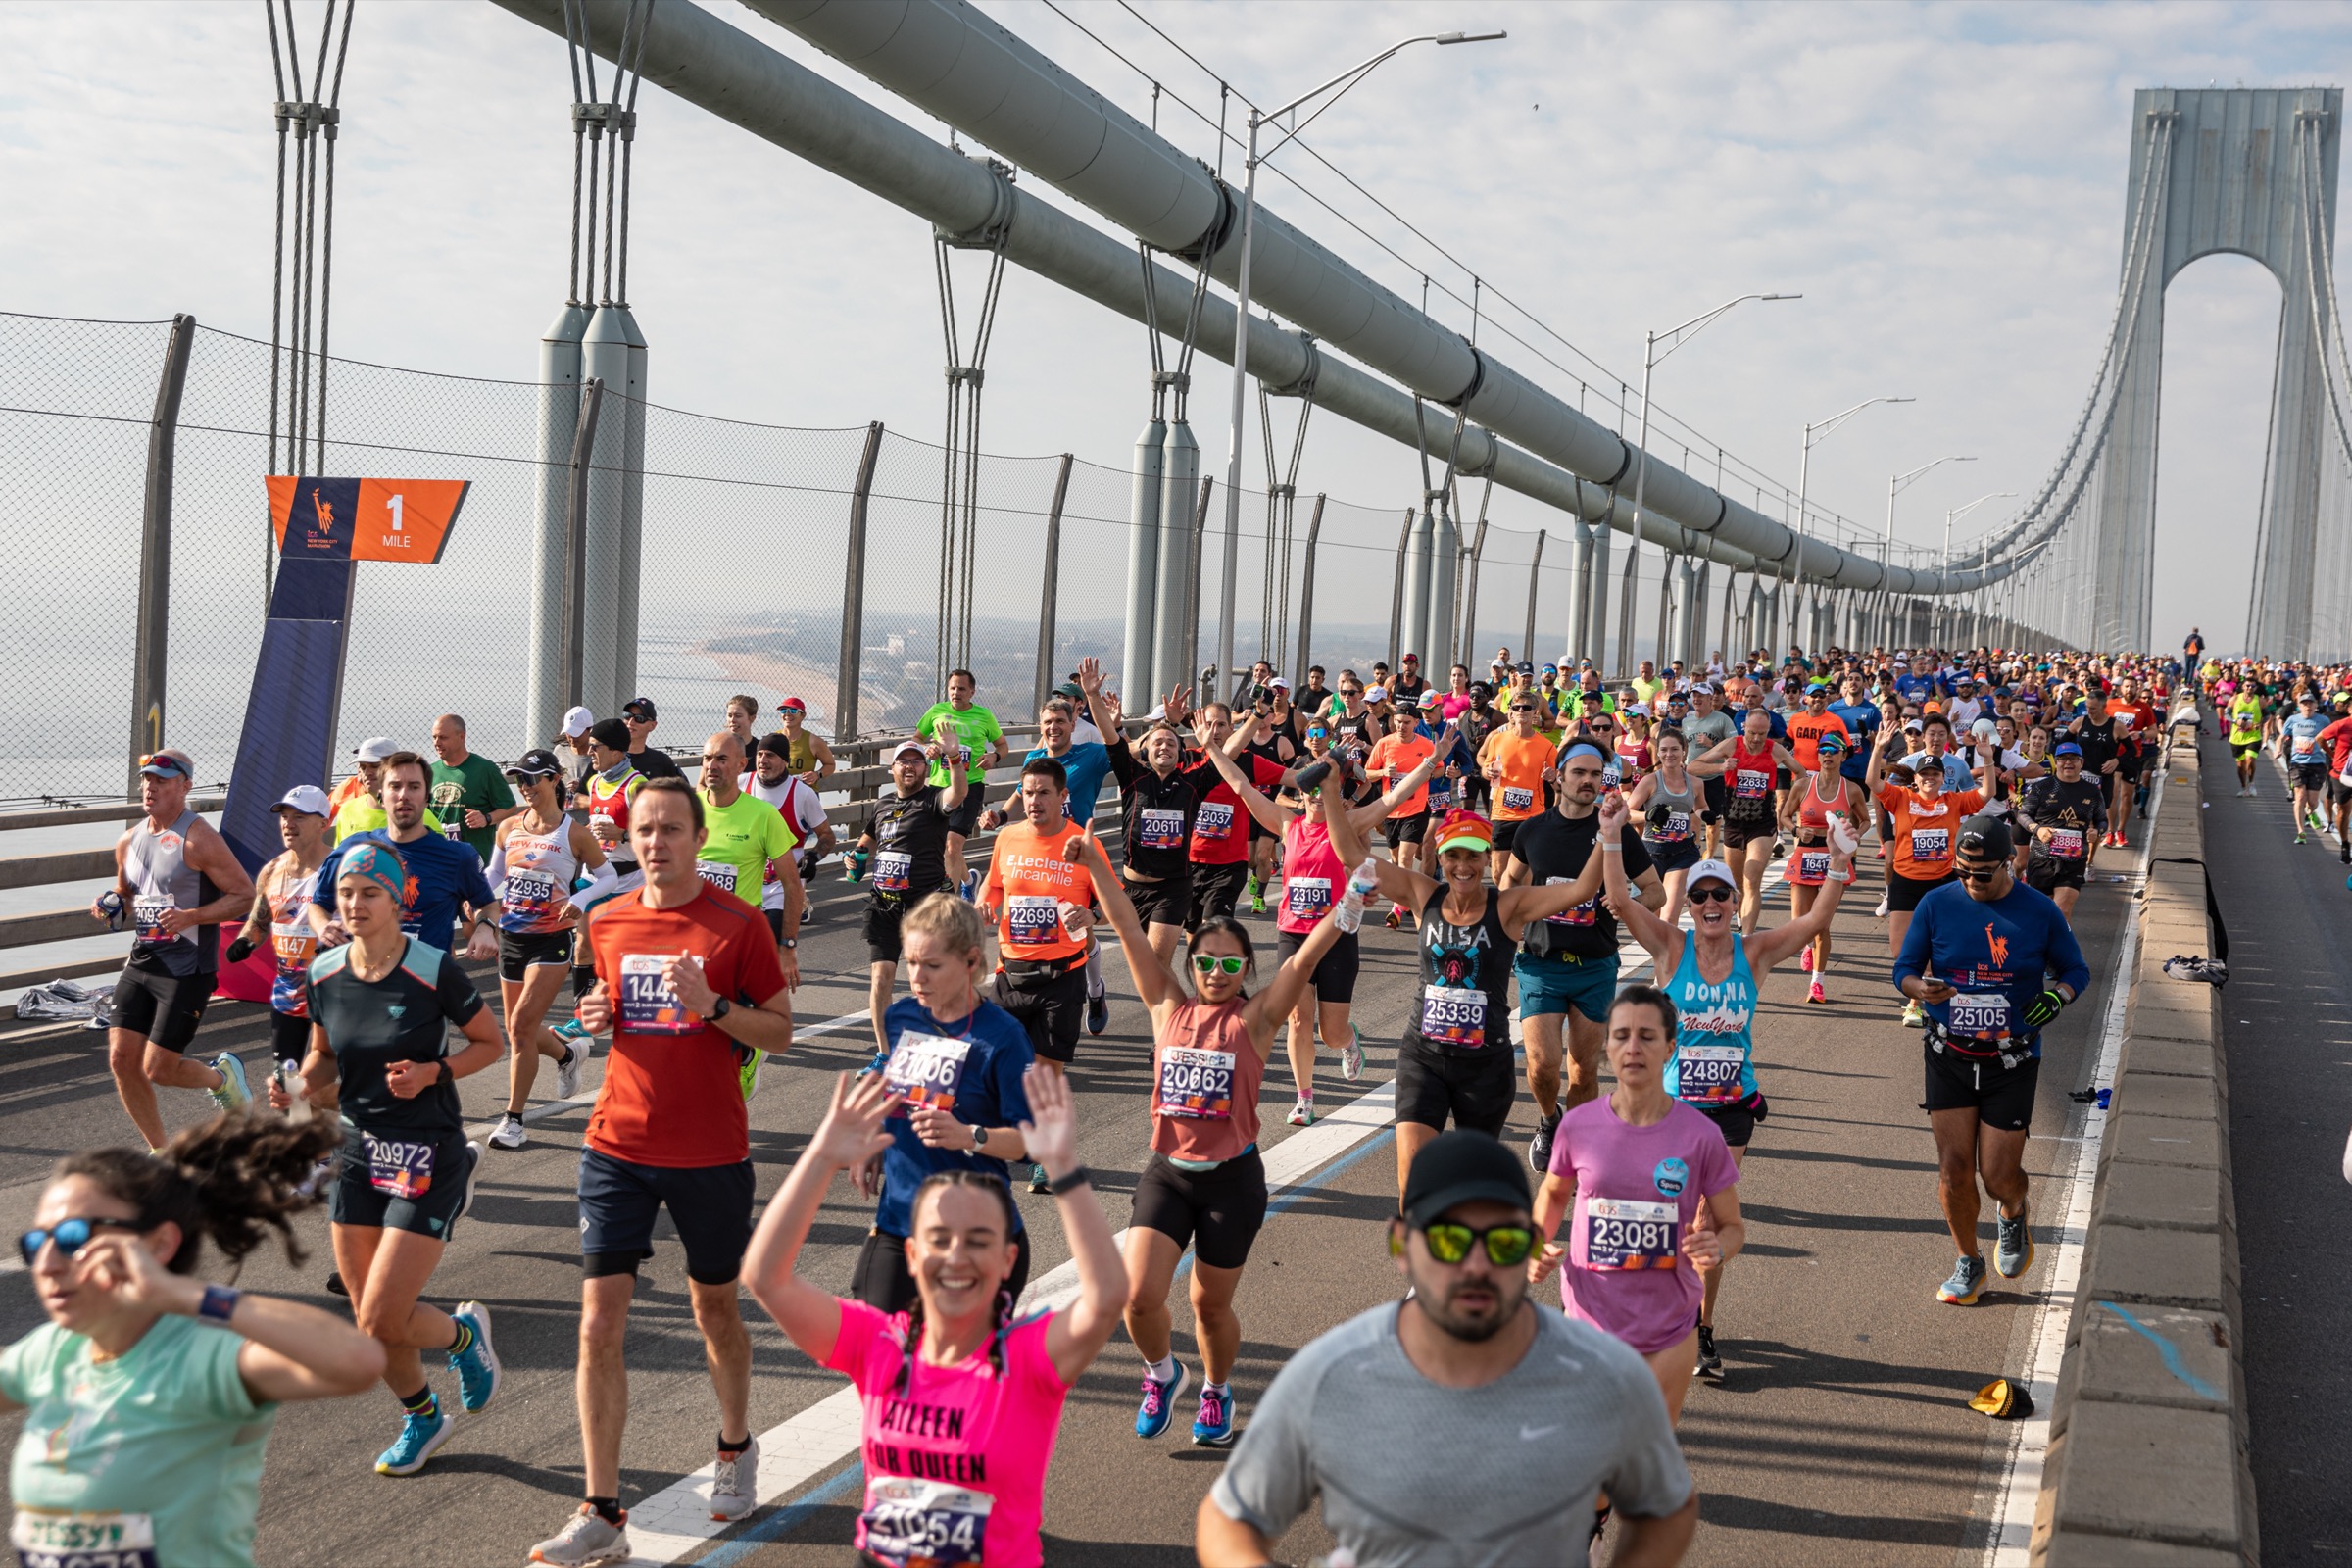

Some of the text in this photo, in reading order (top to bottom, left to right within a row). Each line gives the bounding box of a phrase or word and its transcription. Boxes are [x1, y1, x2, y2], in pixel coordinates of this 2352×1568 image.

[386, 494, 404, 531] 1
[382, 534, 411, 548] MILE
[1795, 727, 1825, 740] GARY
[1601, 773, 1617, 785] 203
[1737, 776, 1767, 789] 22633
[1505, 792, 1531, 806] 18420
[1197, 809, 1232, 825] 23037
[1145, 820, 1180, 833] 20611
[534, 841, 562, 854] YORK
[1914, 837, 1946, 849] 19054
[2053, 836, 2082, 848] 38869
[876, 861, 906, 875] 16921
[1006, 855, 1074, 873] E.Leclerc
[1010, 866, 1073, 887] Incarville
[509, 877, 550, 898] 22935
[1293, 887, 1327, 903] 23191
[294, 895, 313, 904] YOR
[1010, 907, 1055, 924] 22699
[1426, 920, 1492, 949] NISA
[277, 938, 307, 954] 4147
[1977, 962, 1989, 971] tcs
[628, 975, 679, 1002] 144
[1685, 982, 1748, 1002] DONNA
[1957, 997, 1971, 1005] tcs
[1426, 999, 1483, 1025] 25339
[1953, 1008, 2007, 1026] 25105
[1171, 1050, 1227, 1068] JESSICA
[1687, 1049, 1702, 1058] tcs
[1163, 1063, 1230, 1093] 20662
[1682, 1060, 1741, 1081] 24807
[367, 1139, 432, 1169] 20972
[1660, 1179, 1681, 1191] Sports
[1598, 1203, 1617, 1216] tcs
[1593, 1218, 1670, 1250] 23081
[475, 1340, 493, 1372] HOKA
[881, 1400, 965, 1440] AILEEN
[908, 1448, 986, 1483] QUEEN
[871, 1503, 976, 1552] 21054
